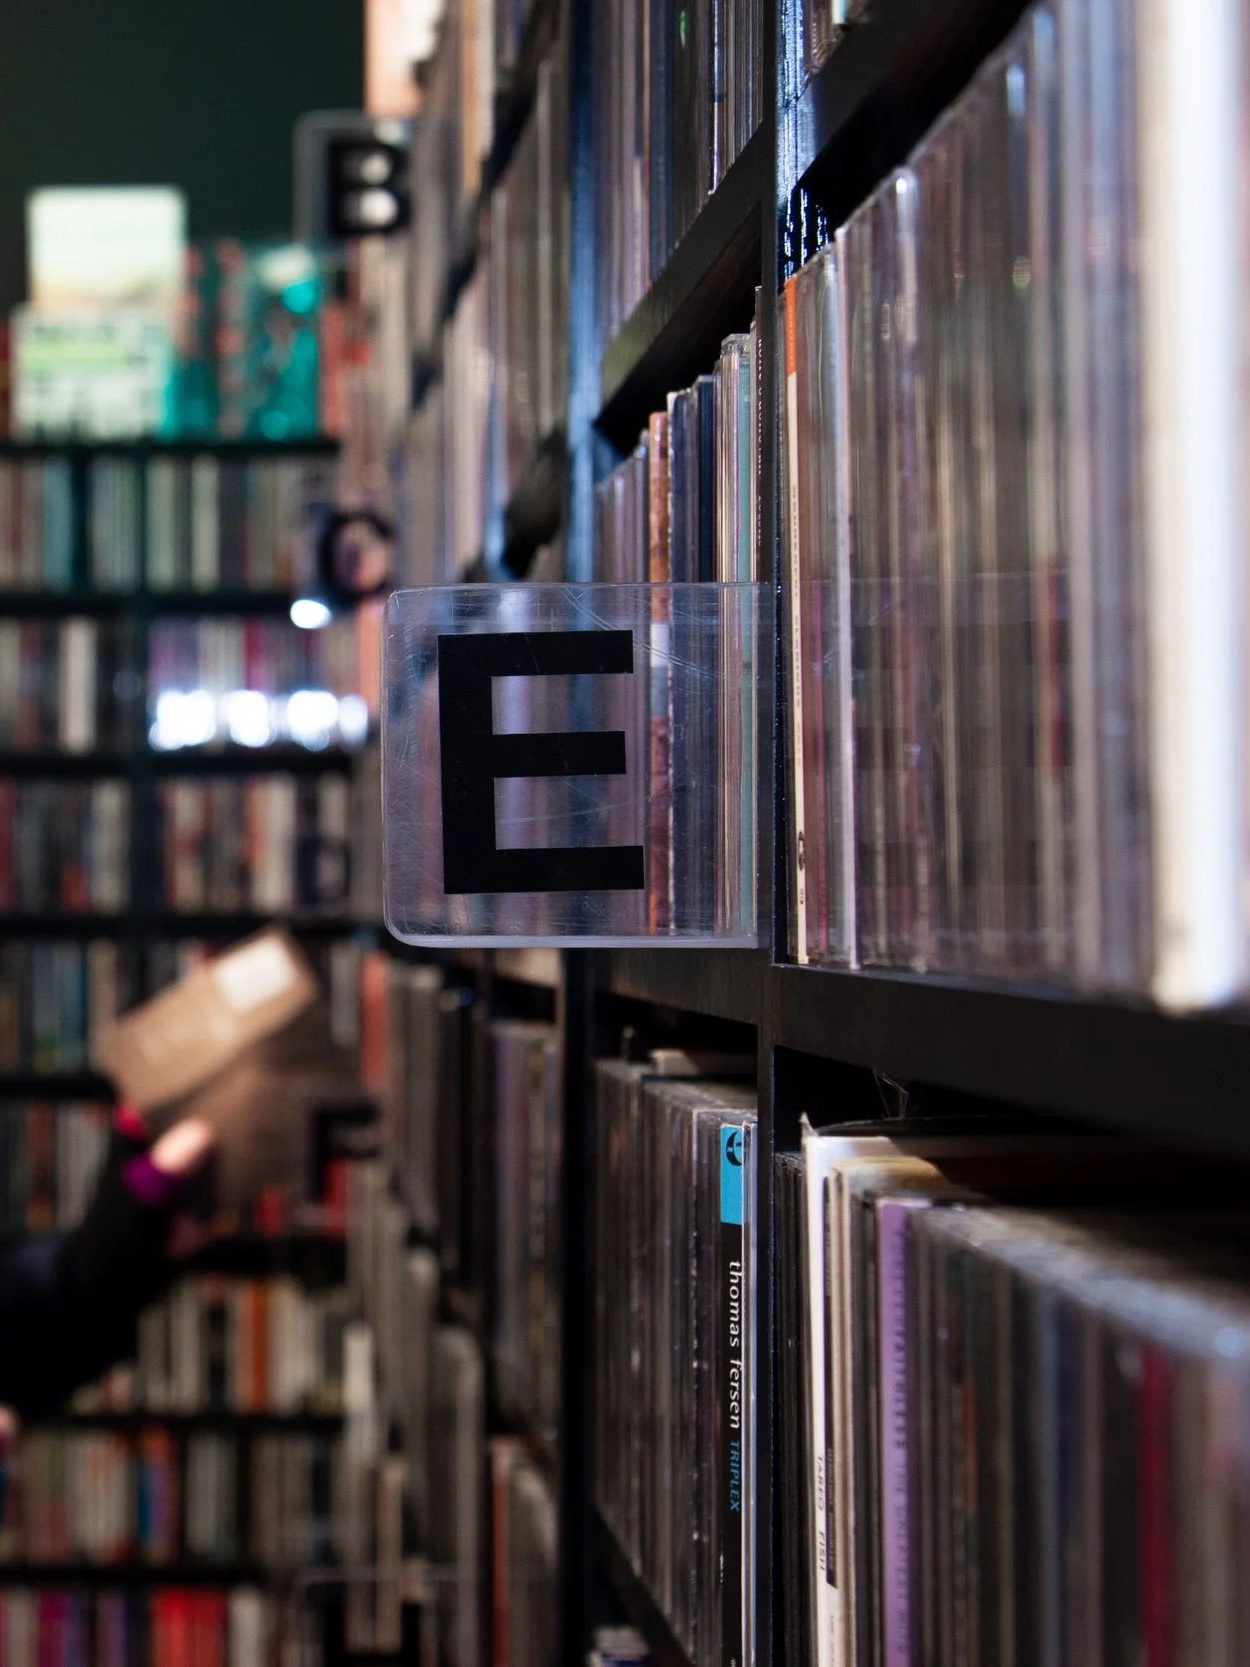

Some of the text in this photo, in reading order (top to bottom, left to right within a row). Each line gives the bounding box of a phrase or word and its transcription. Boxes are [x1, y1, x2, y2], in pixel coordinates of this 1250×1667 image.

[328, 137, 411, 234] B
[437, 629, 645, 895] E
[312, 1103, 382, 1202] F
[728, 1260, 743, 1513] thomas fersen TRIPLEX
